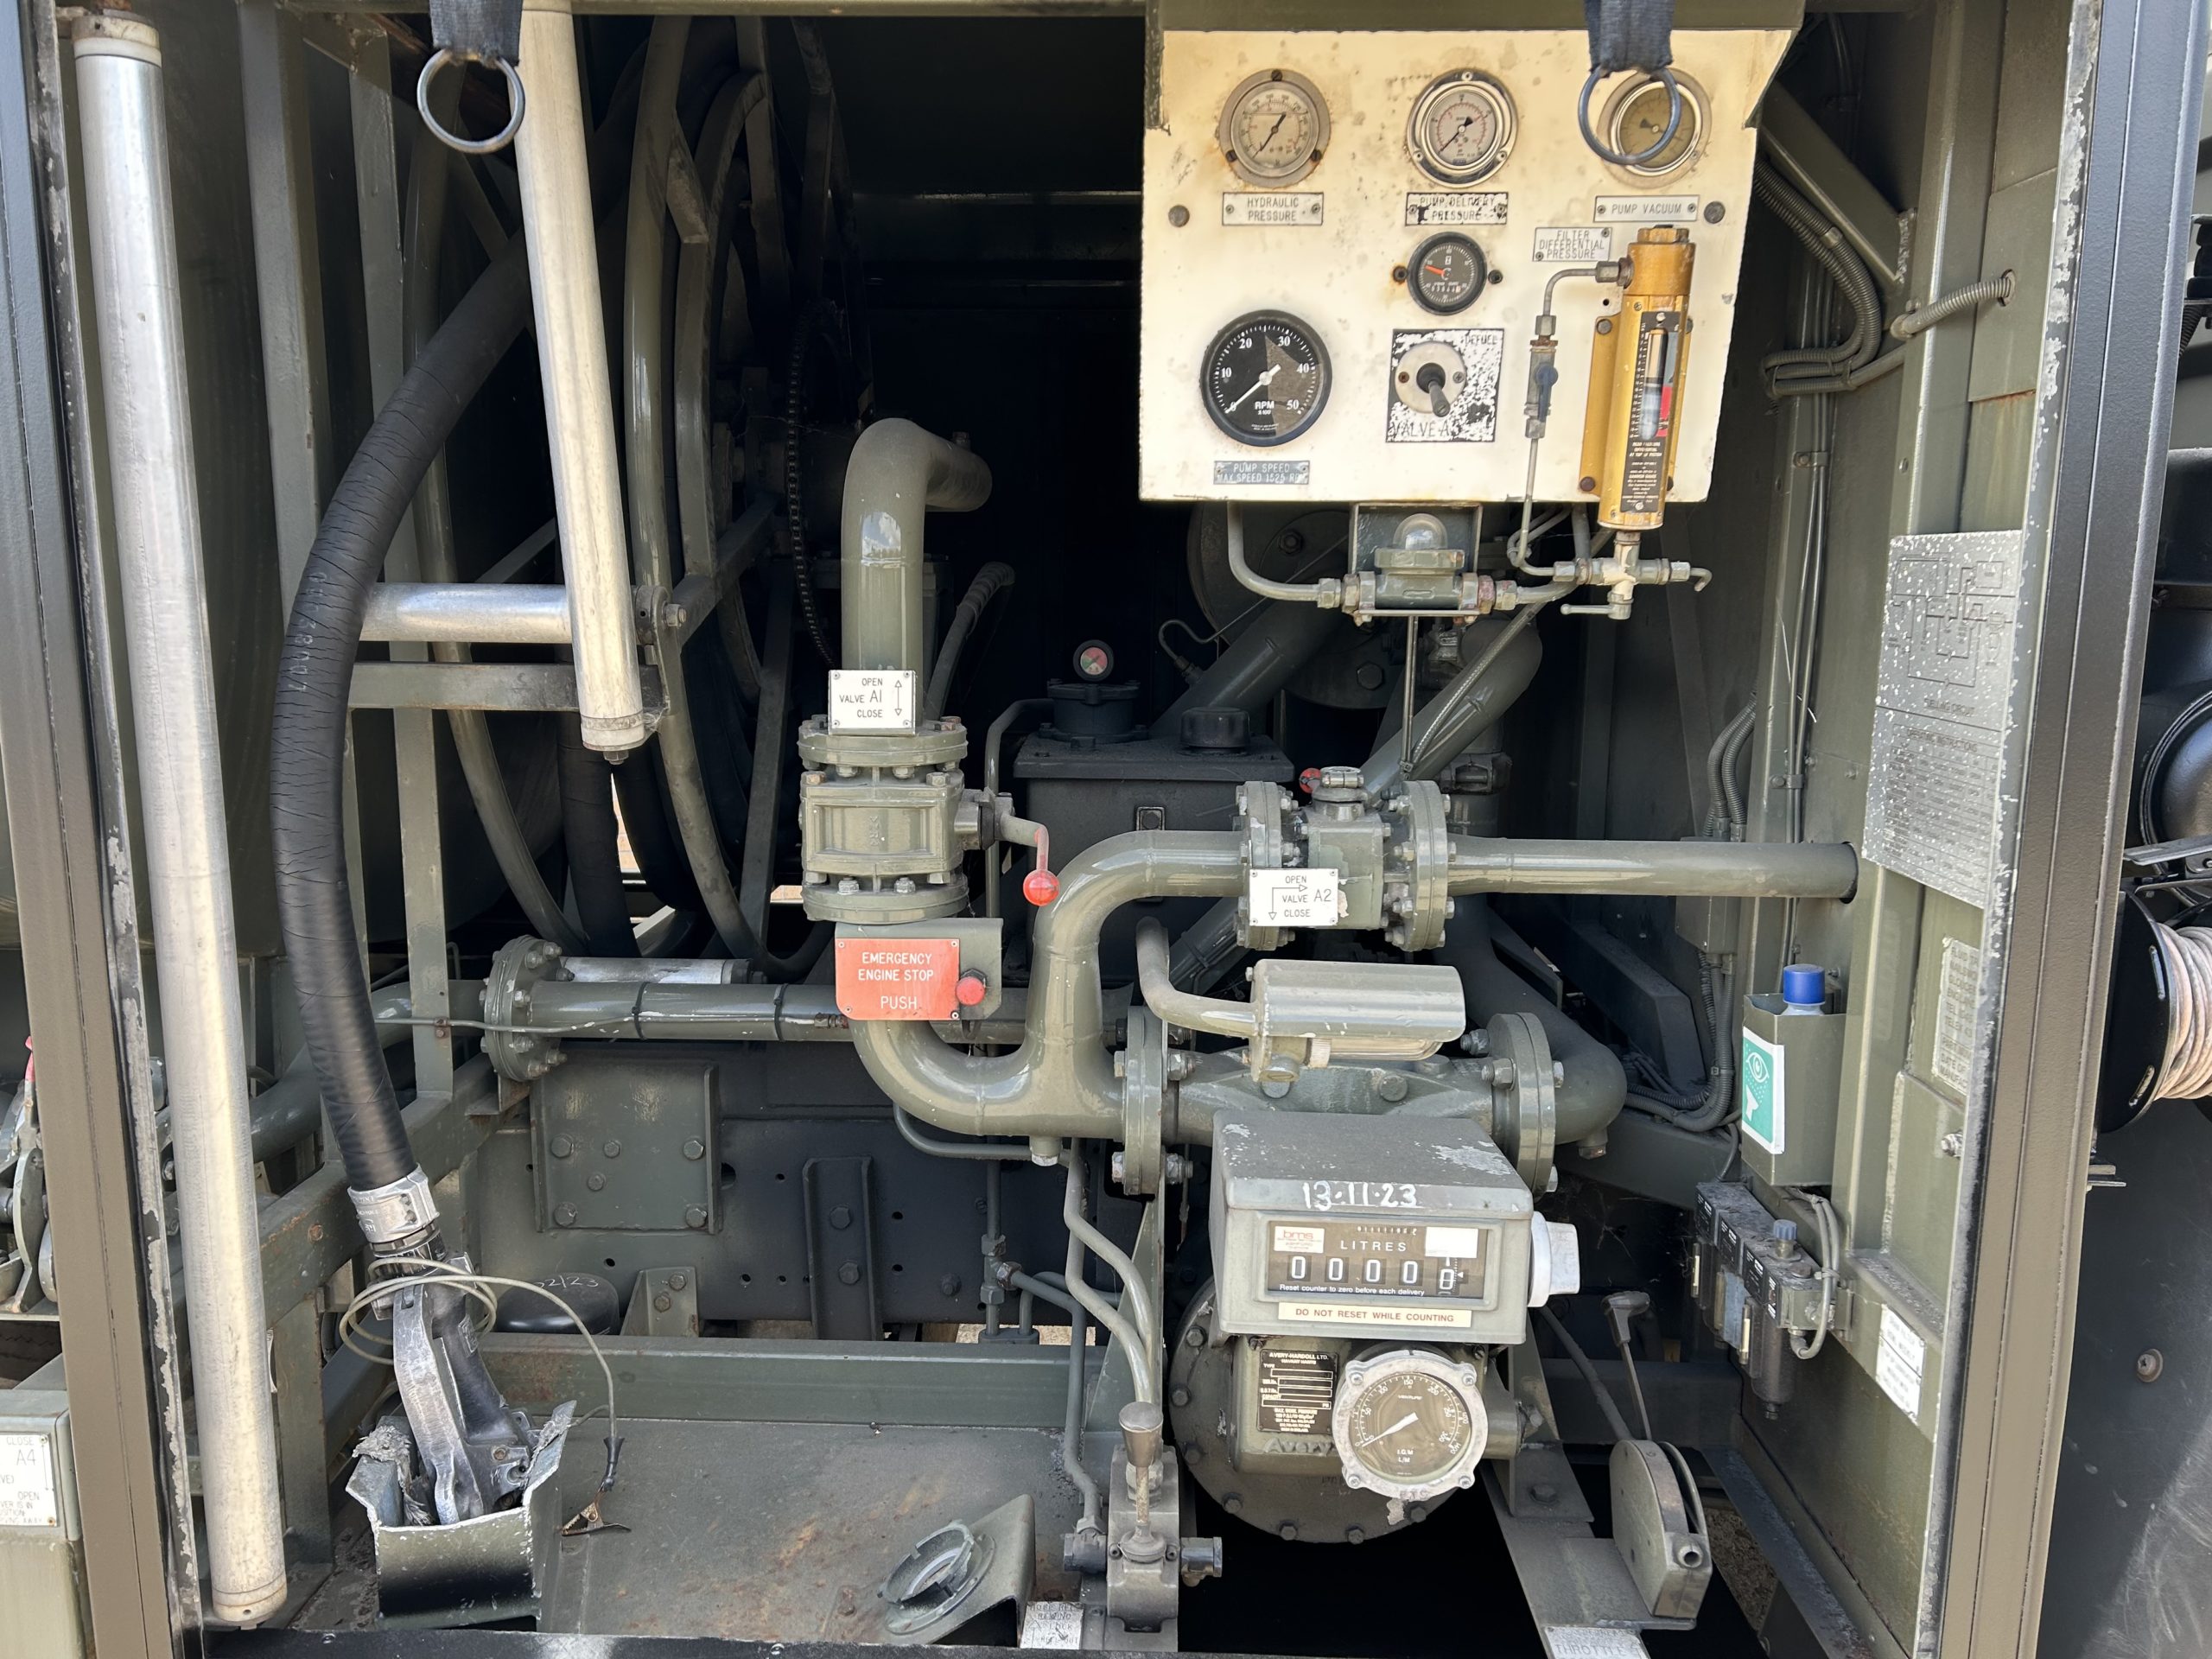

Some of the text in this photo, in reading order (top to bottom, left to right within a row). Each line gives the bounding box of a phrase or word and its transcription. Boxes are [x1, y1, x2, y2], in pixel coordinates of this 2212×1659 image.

[1247, 197, 1300, 207] HYDRAULIC
[1611, 203, 1682, 214] PUMP VACUUM
[1248, 211, 1297, 221] PRESSURE
[1556, 230, 1590, 240] FILTER
[1539, 239, 1605, 250] DIFFERENTIAL
[1547, 249, 1596, 259] PRESSURE
[1238, 338, 1253, 349] 20
[1278, 336, 1291, 346] 30
[1220, 367, 1232, 378] 10
[1297, 363, 1310, 374] 40
[1287, 399, 1300, 410] 50
[1234, 462, 1290, 473] PUMP SPEED
[1236, 473, 1262, 483] SPEED
[861, 677, 883, 687] OPEN
[839, 694, 865, 704] VALVE
[857, 709, 883, 718] CLOSE
[1285, 875, 1307, 884] OPEN
[1282, 888, 1332, 904] VALVE A2
[1284, 909, 1311, 918] CLOSE
[861, 951, 932, 965] EMERGENCY
[858, 969, 934, 982] ENGINE STOP
[880, 996, 918, 1010] PUSH
[1283, 1230, 1314, 1240] bms
[1340, 1239, 1407, 1252] LITRES
[1398, 1287, 1425, 1297] delivery
[1295, 1307, 1454, 1323] DO NOT RESET WHILE COUNTING
[6, 1436, 35, 1446] CLOSE
[16, 1448, 36, 1466] A4
[17, 1491, 41, 1501] OPEN
[1555, 1643, 1625, 1656] THROTTLE
